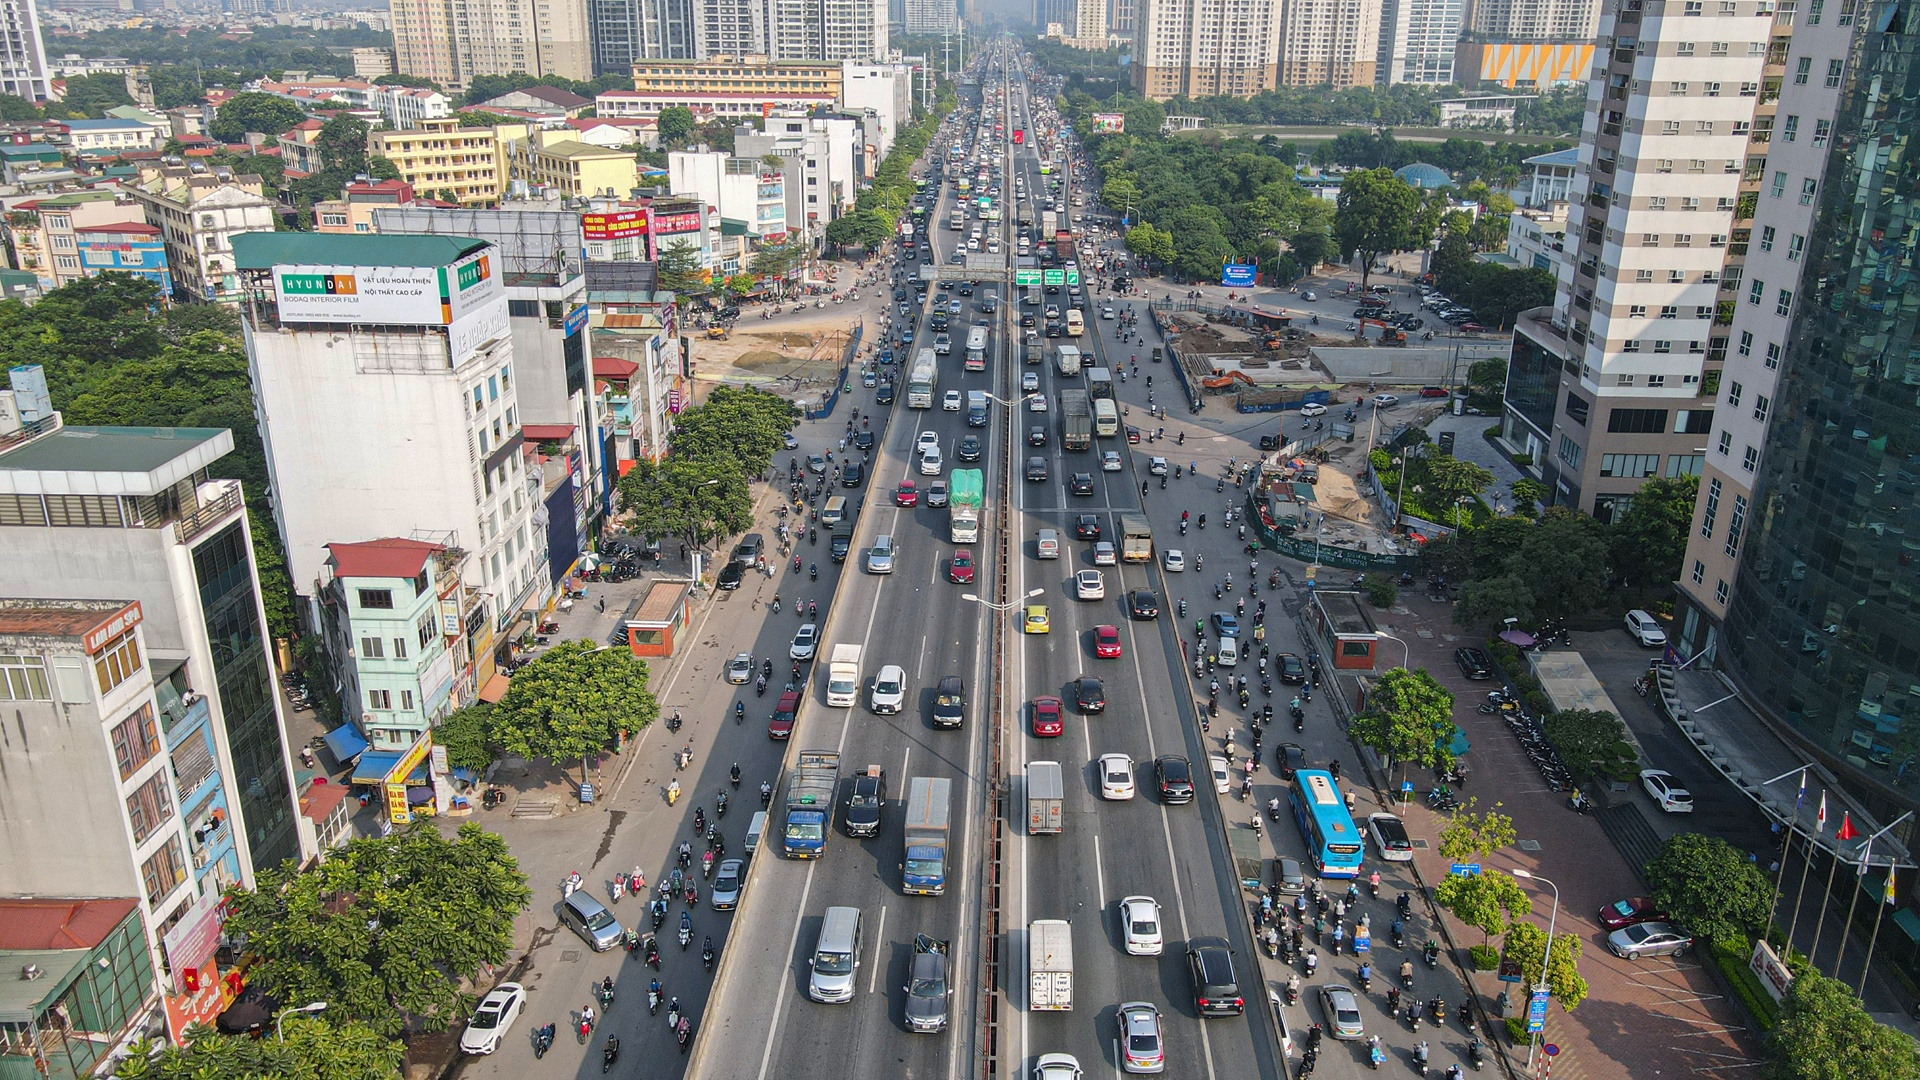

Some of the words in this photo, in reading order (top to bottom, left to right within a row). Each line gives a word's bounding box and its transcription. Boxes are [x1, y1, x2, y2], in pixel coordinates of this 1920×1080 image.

[460, 262, 489, 284] HYUNDAI
[286, 280, 352, 290] HYUNDAI
[457, 332, 468, 357] XE
[108, 617, 124, 638] ANH
[124, 607, 141, 626] SPA
